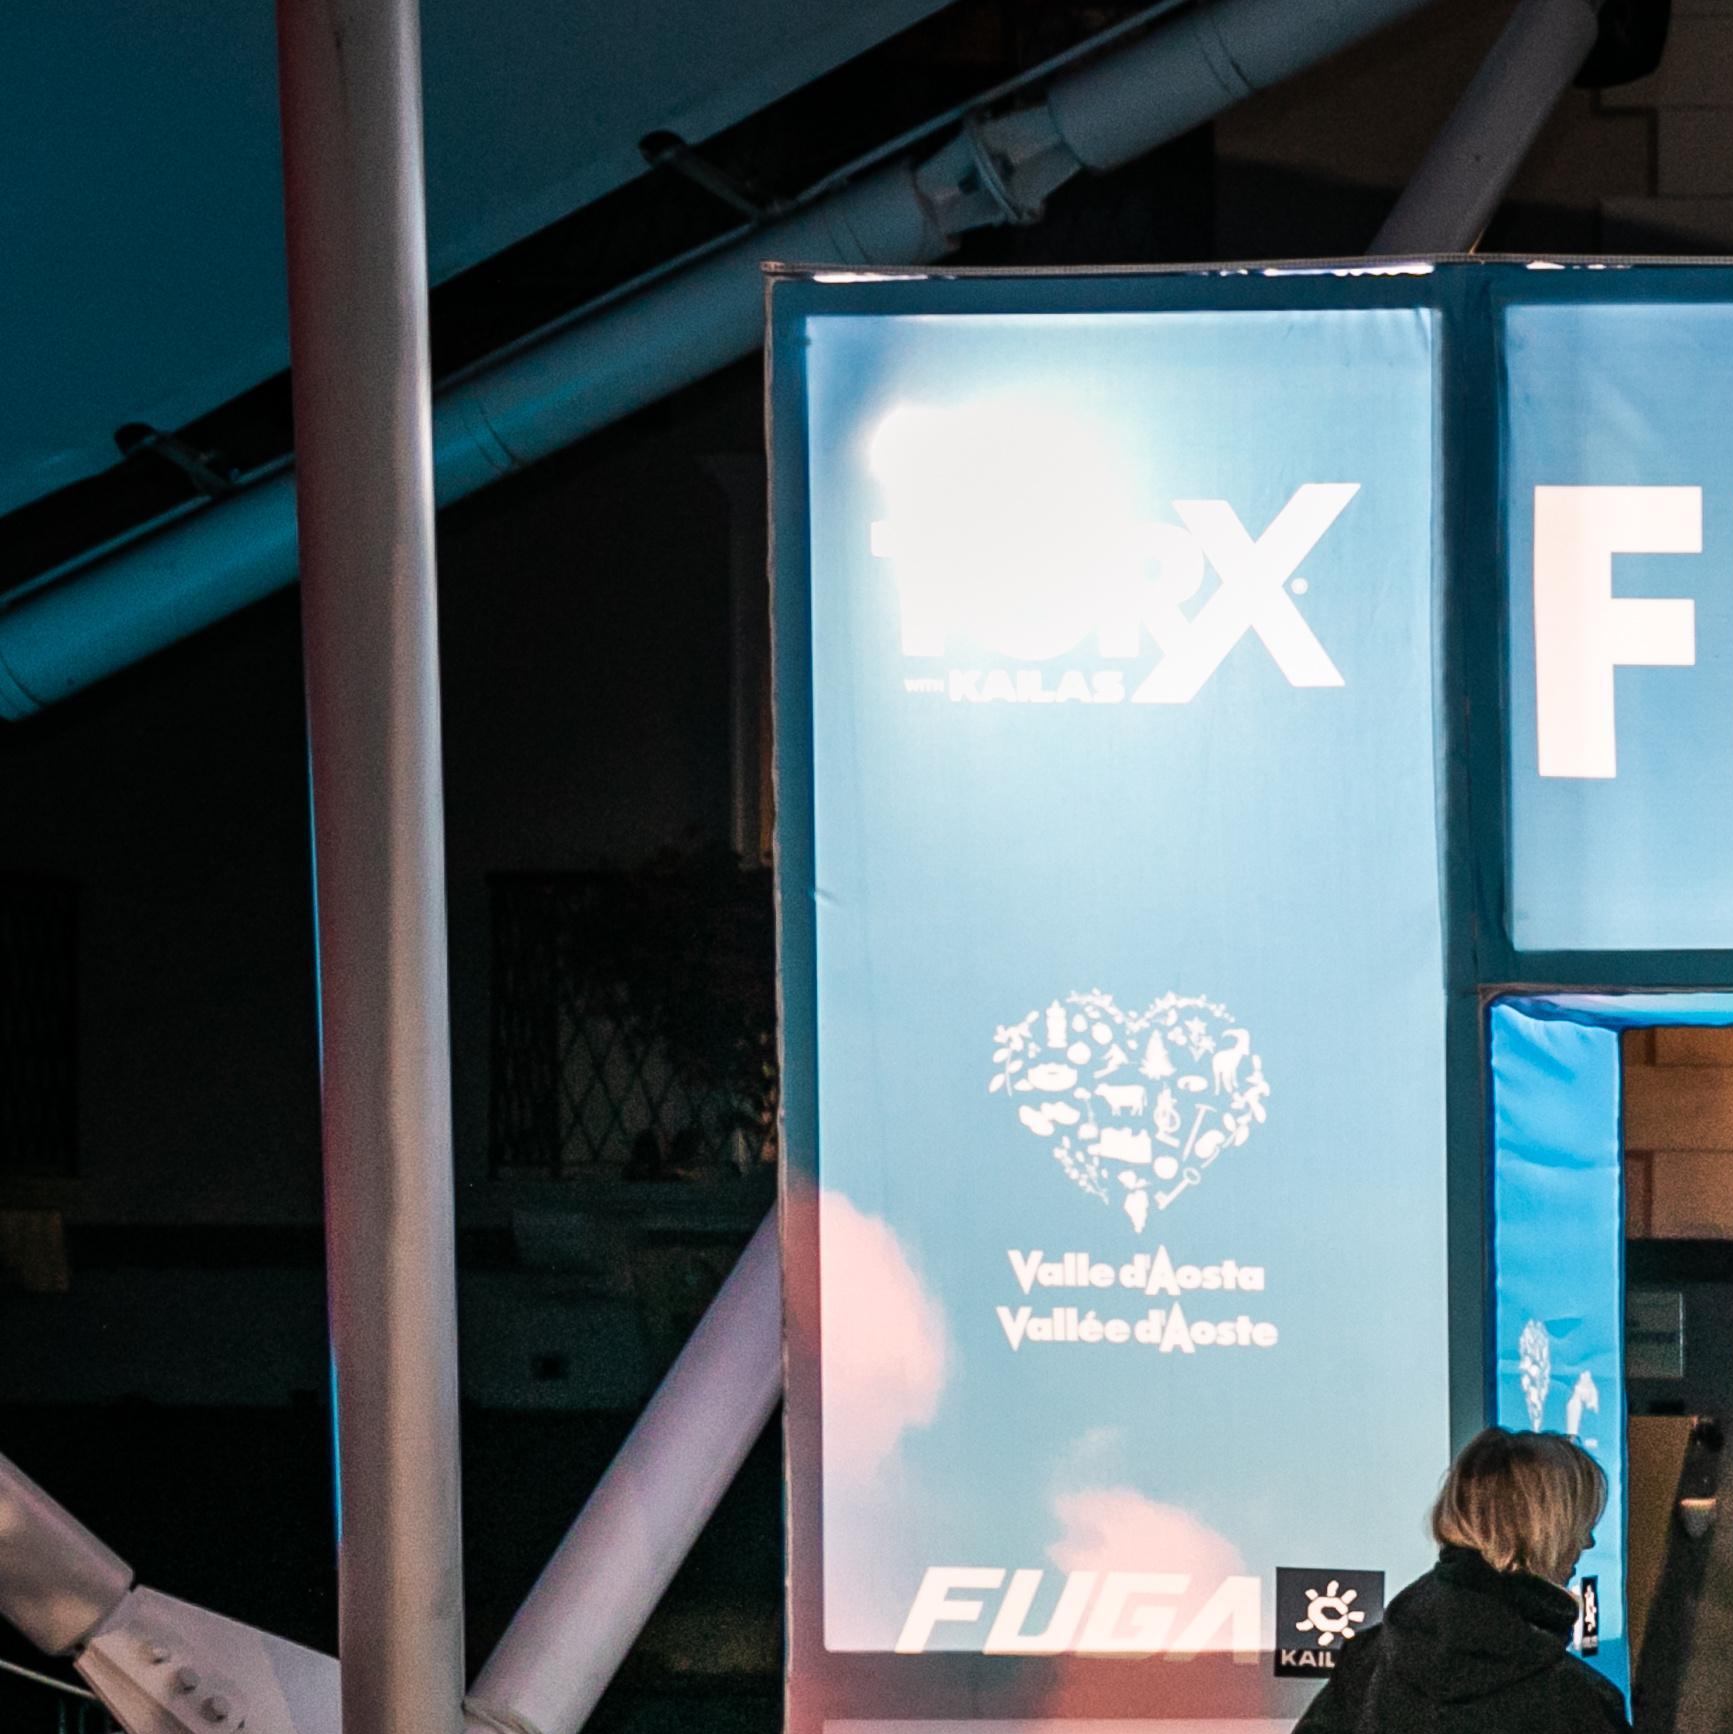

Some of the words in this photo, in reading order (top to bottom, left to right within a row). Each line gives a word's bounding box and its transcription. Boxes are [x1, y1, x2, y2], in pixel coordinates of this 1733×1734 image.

[871, 483, 1361, 703] RX
[948, 670, 1125, 704] KAILAS
[1008, 1249, 1115, 1295] Valle
[1118, 1245, 1266, 1296] d'Aosta
[996, 1306, 1131, 1352] Vallée
[1134, 1302, 1279, 1354] d'Aoste
[895, 1566, 1263, 1665] FUGA
[1281, 1648, 1336, 1669] KAIL
